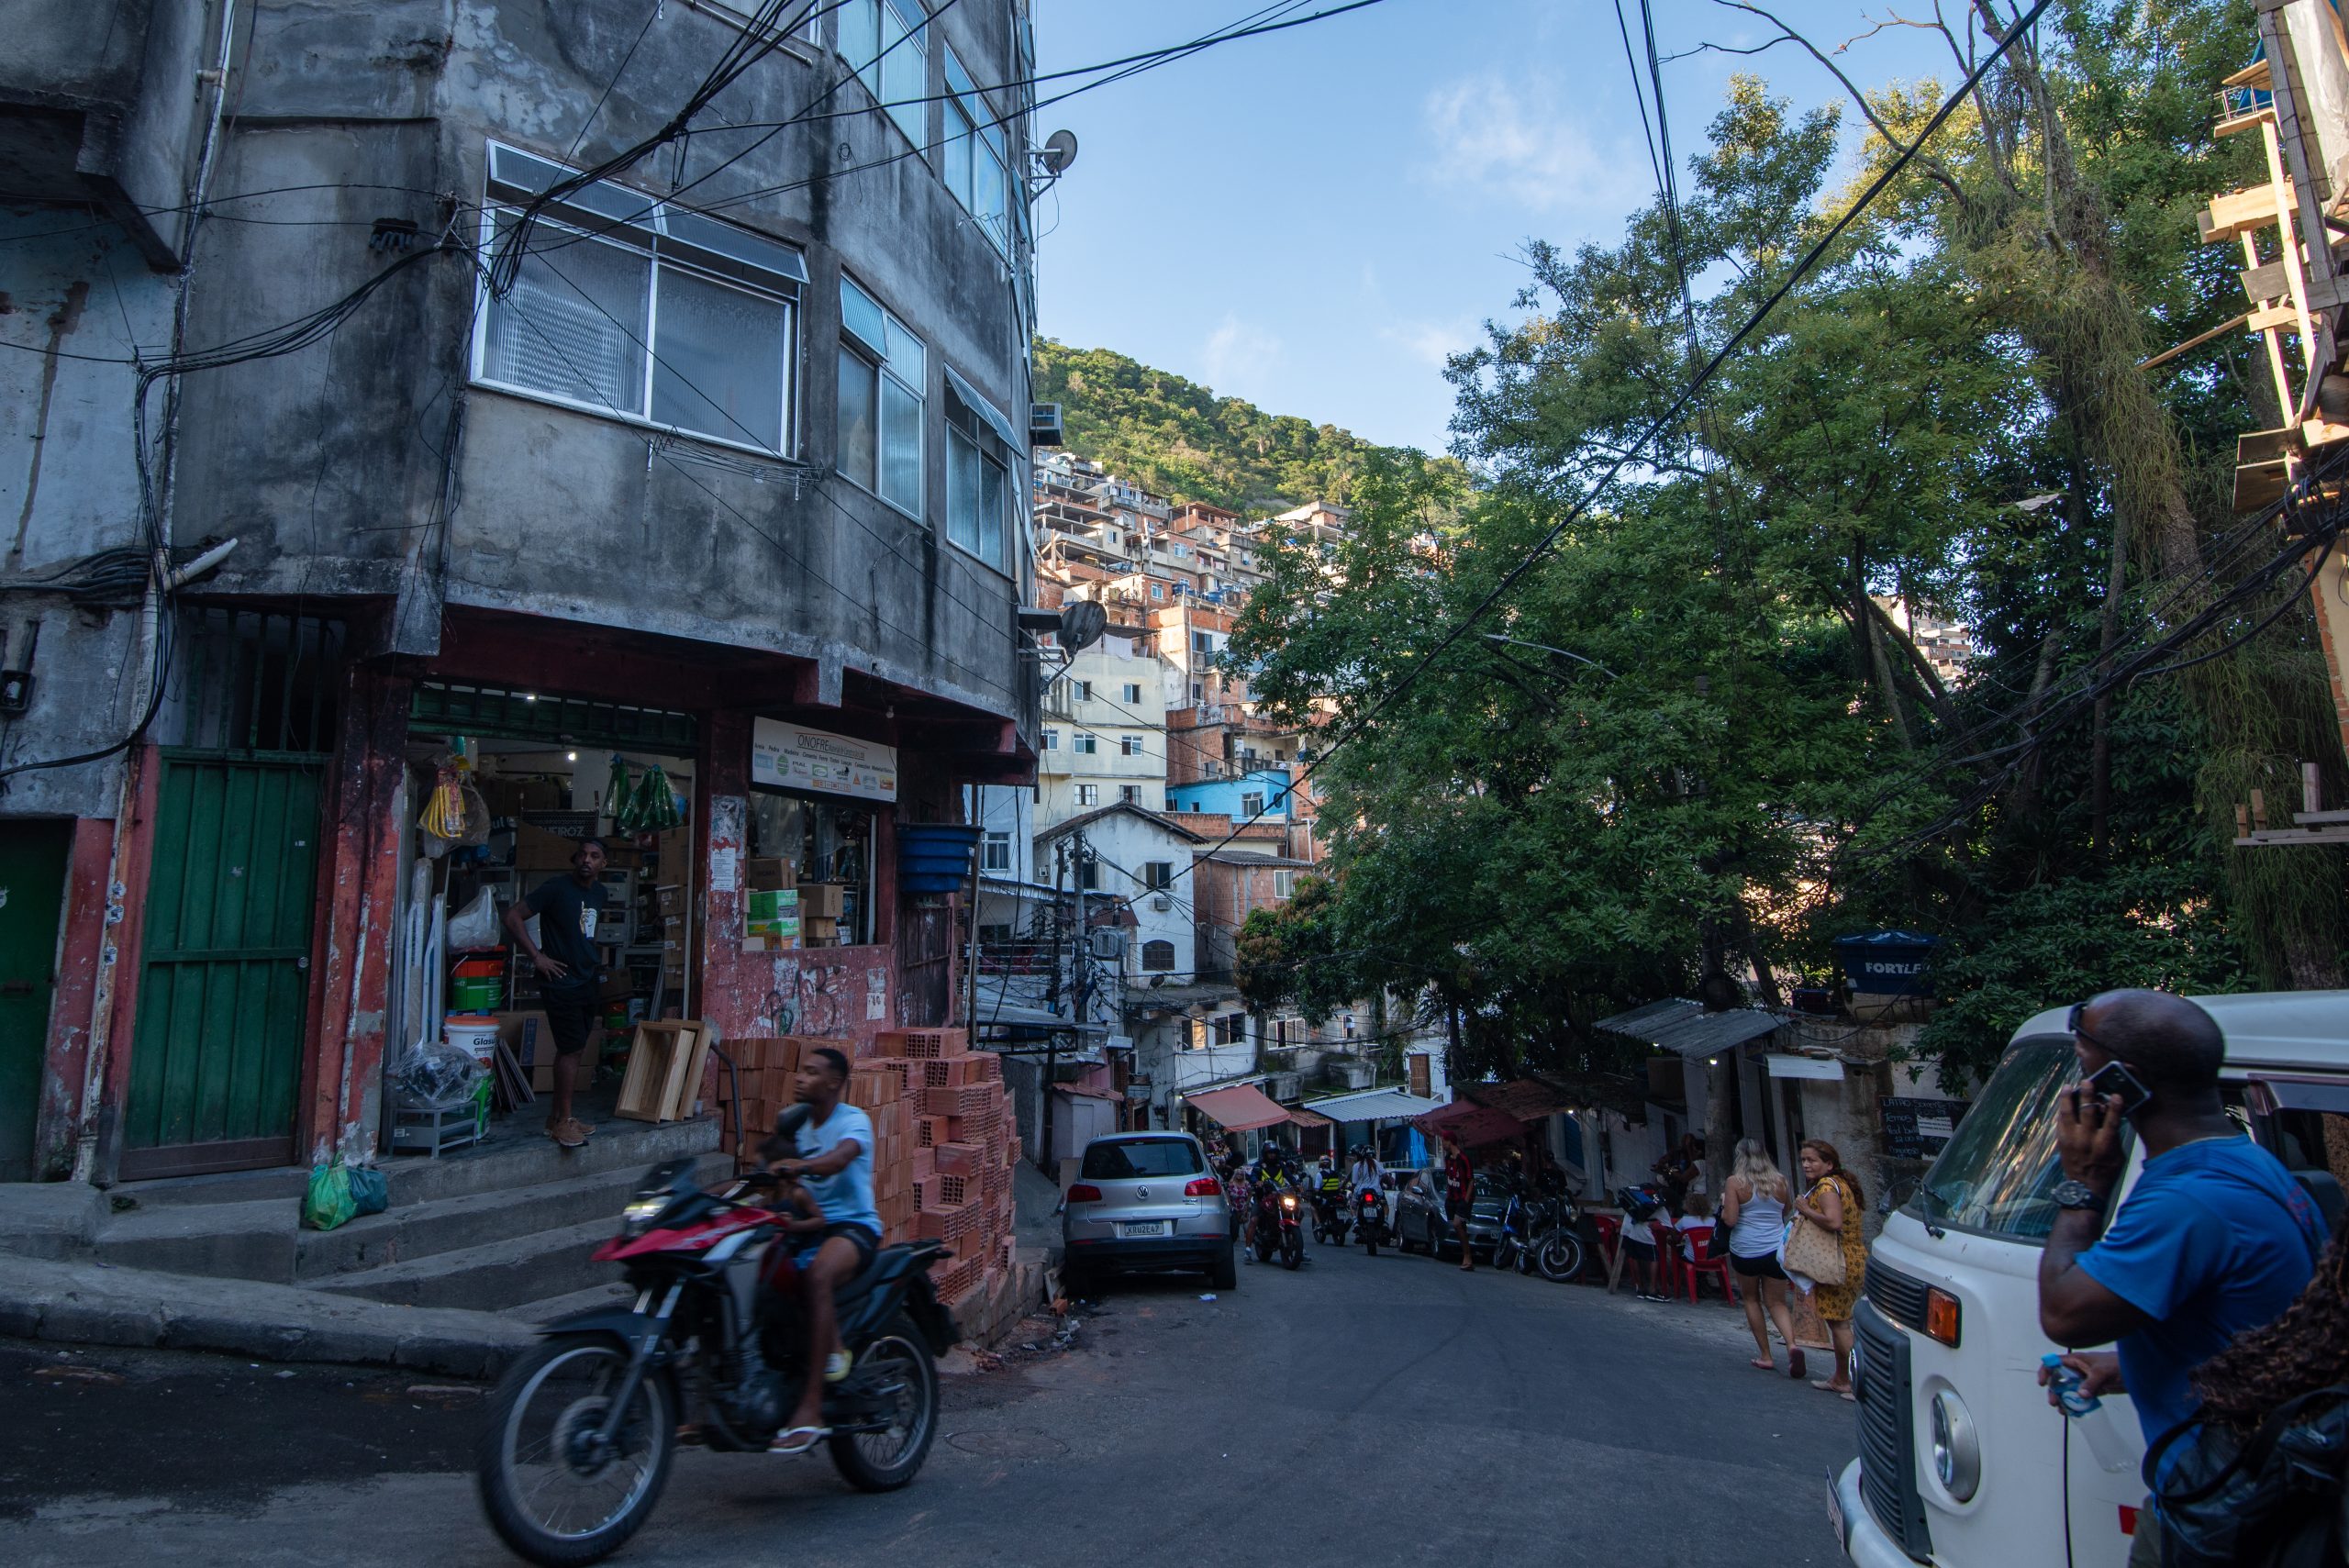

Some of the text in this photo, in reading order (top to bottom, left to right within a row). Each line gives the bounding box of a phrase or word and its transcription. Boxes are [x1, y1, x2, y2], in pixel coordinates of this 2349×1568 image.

[797, 734, 829, 751] ONOFRE
[768, 744, 780, 752] Pedra
[784, 748, 799, 756] Madeira
[803, 751, 818, 760] Cimento
[1865, 962, 1930, 974] FORTLE
